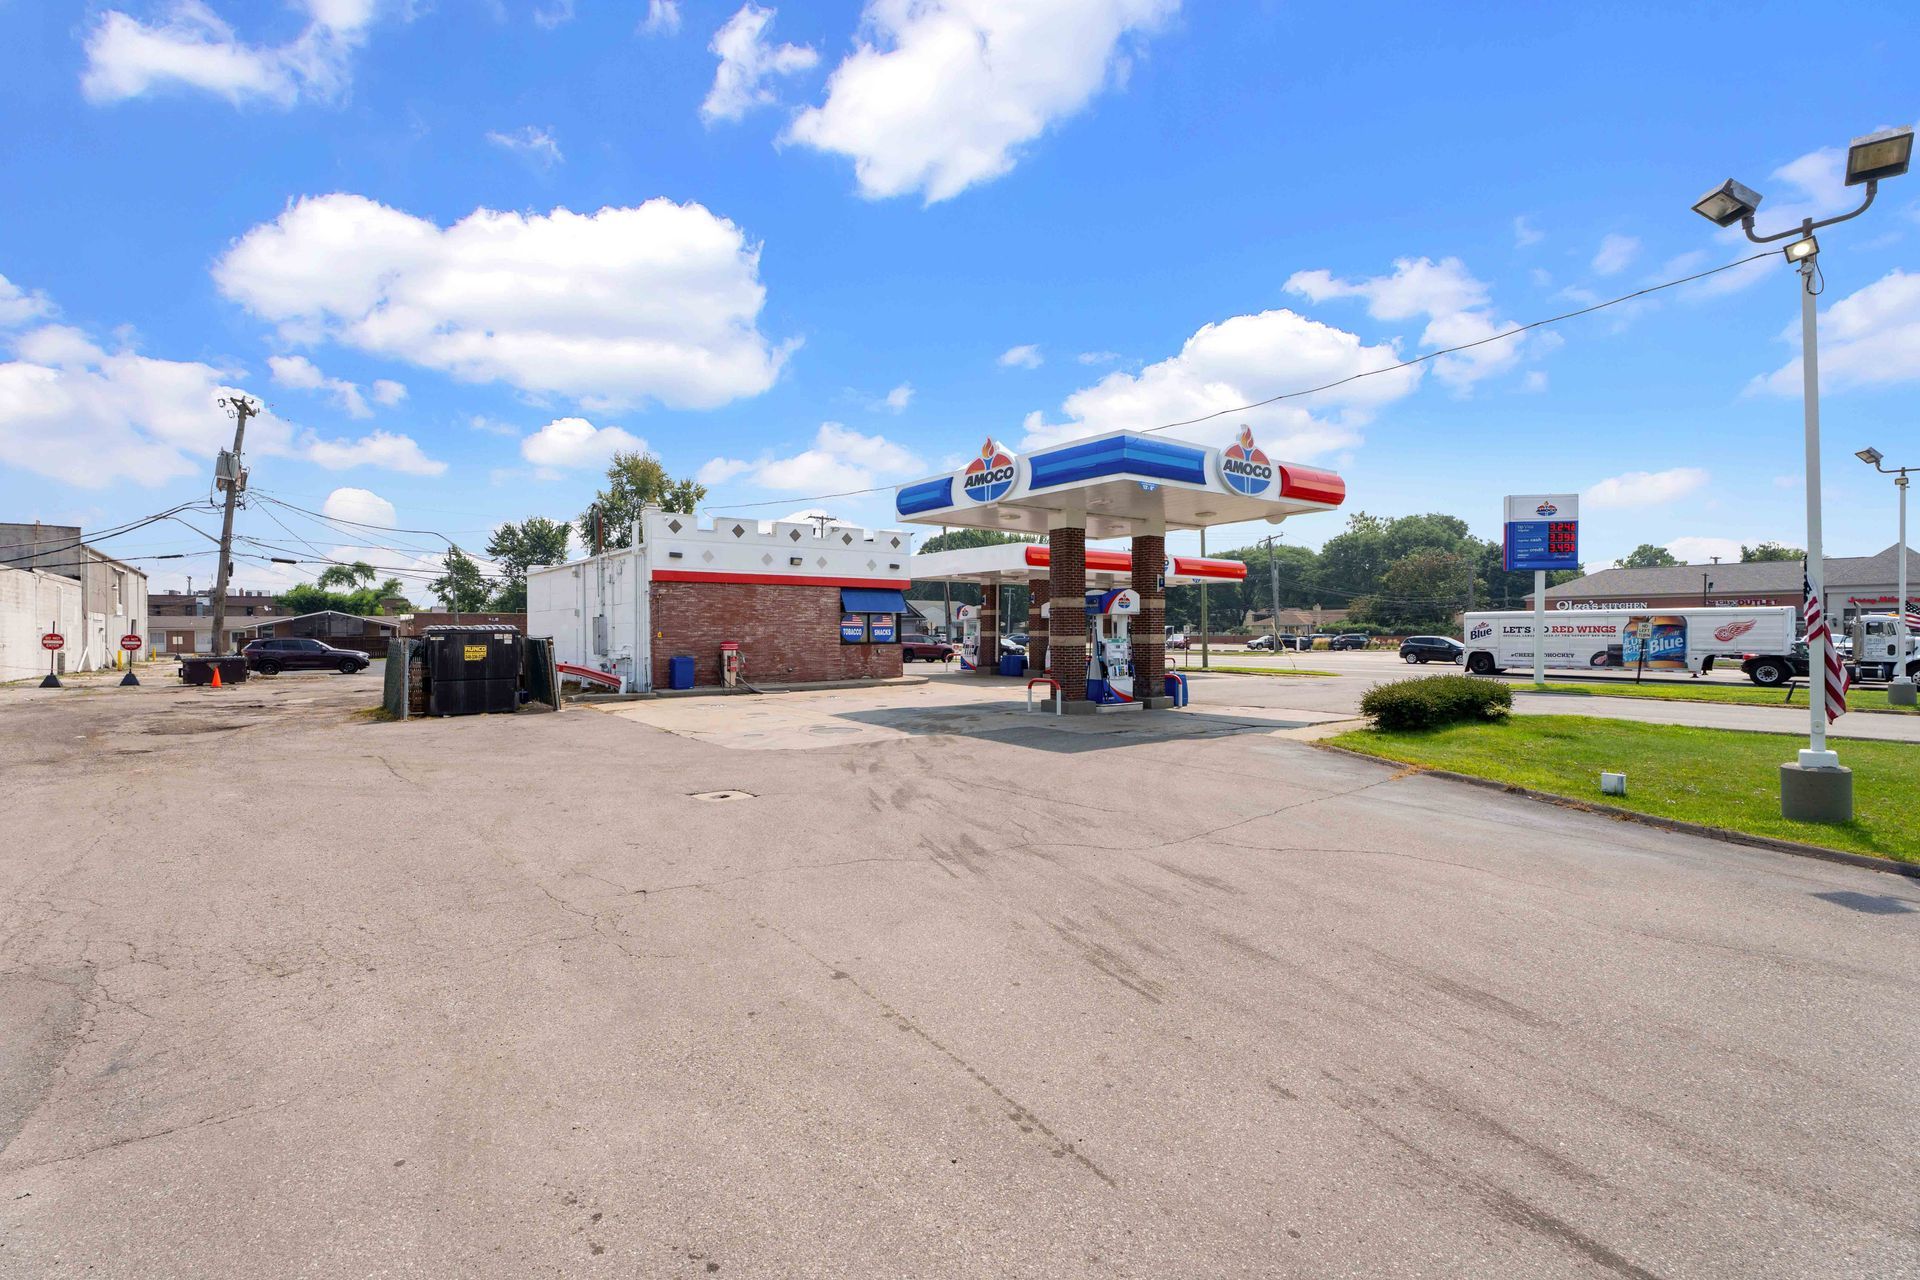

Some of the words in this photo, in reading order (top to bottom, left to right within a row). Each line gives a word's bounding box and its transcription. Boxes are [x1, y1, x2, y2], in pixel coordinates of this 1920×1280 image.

[1223, 459, 1272, 479] AMOCO
[963, 466, 1014, 489] AMOCO
[1556, 600, 1599, 610] Olga's
[842, 628, 862, 636] TOBACCO
[1470, 627, 1493, 641] Blue
[1503, 626, 1531, 634] LET'S
[1577, 625, 1616, 633] WINGS
[1649, 637, 1684, 654] Blue
